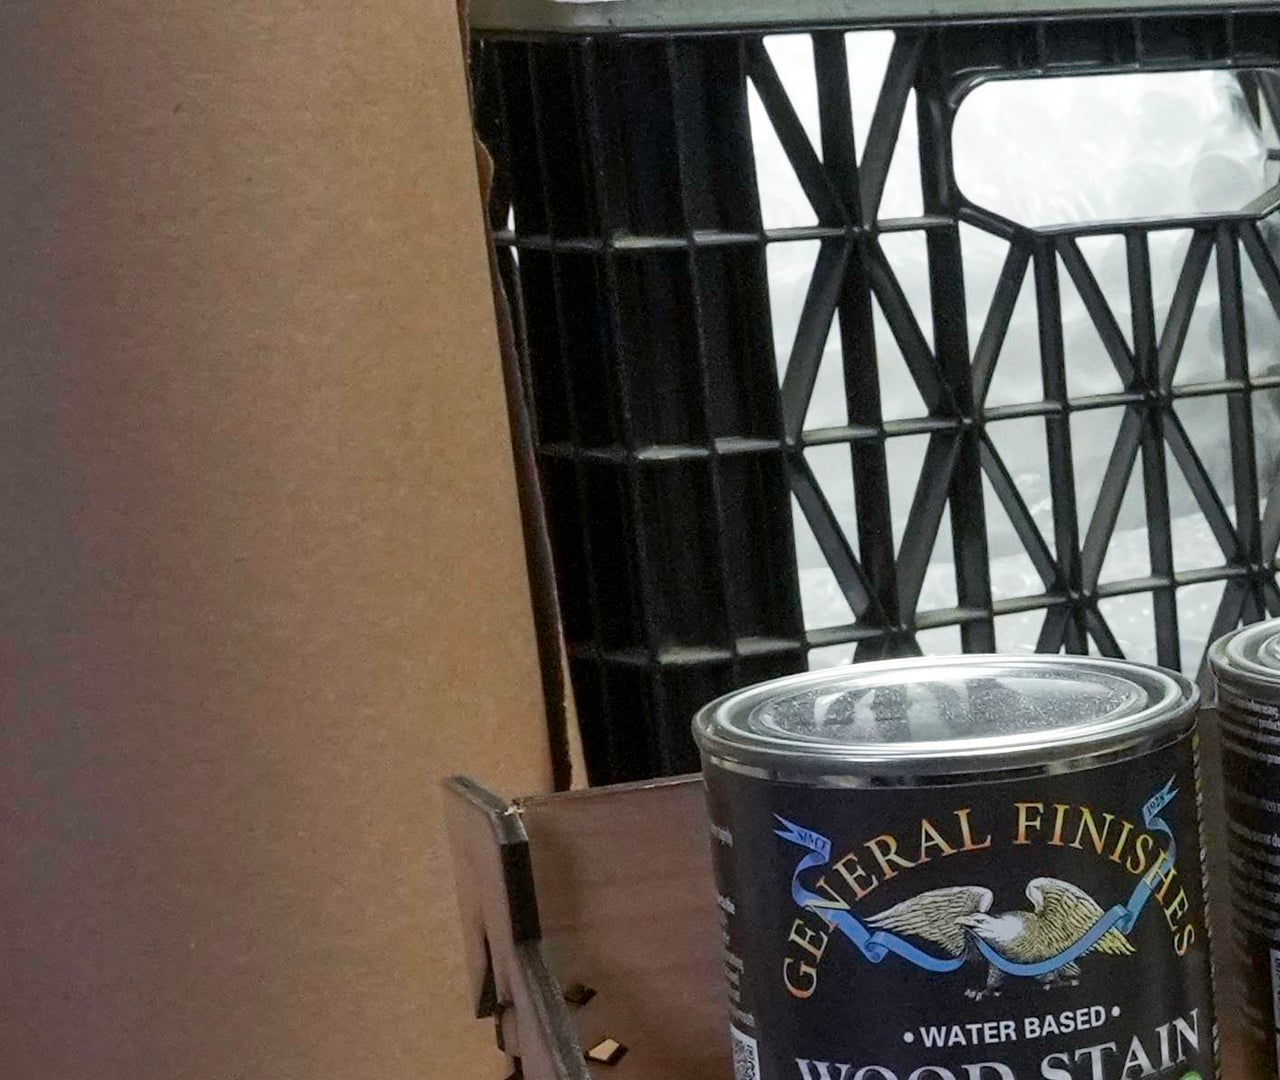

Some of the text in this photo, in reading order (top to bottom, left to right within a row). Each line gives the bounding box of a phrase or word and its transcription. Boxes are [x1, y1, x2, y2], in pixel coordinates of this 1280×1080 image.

[782, 807, 992, 999] GENERAL
[1013, 802, 1196, 958] FINISHES
[920, 1005, 1107, 1048] WATER BASED
